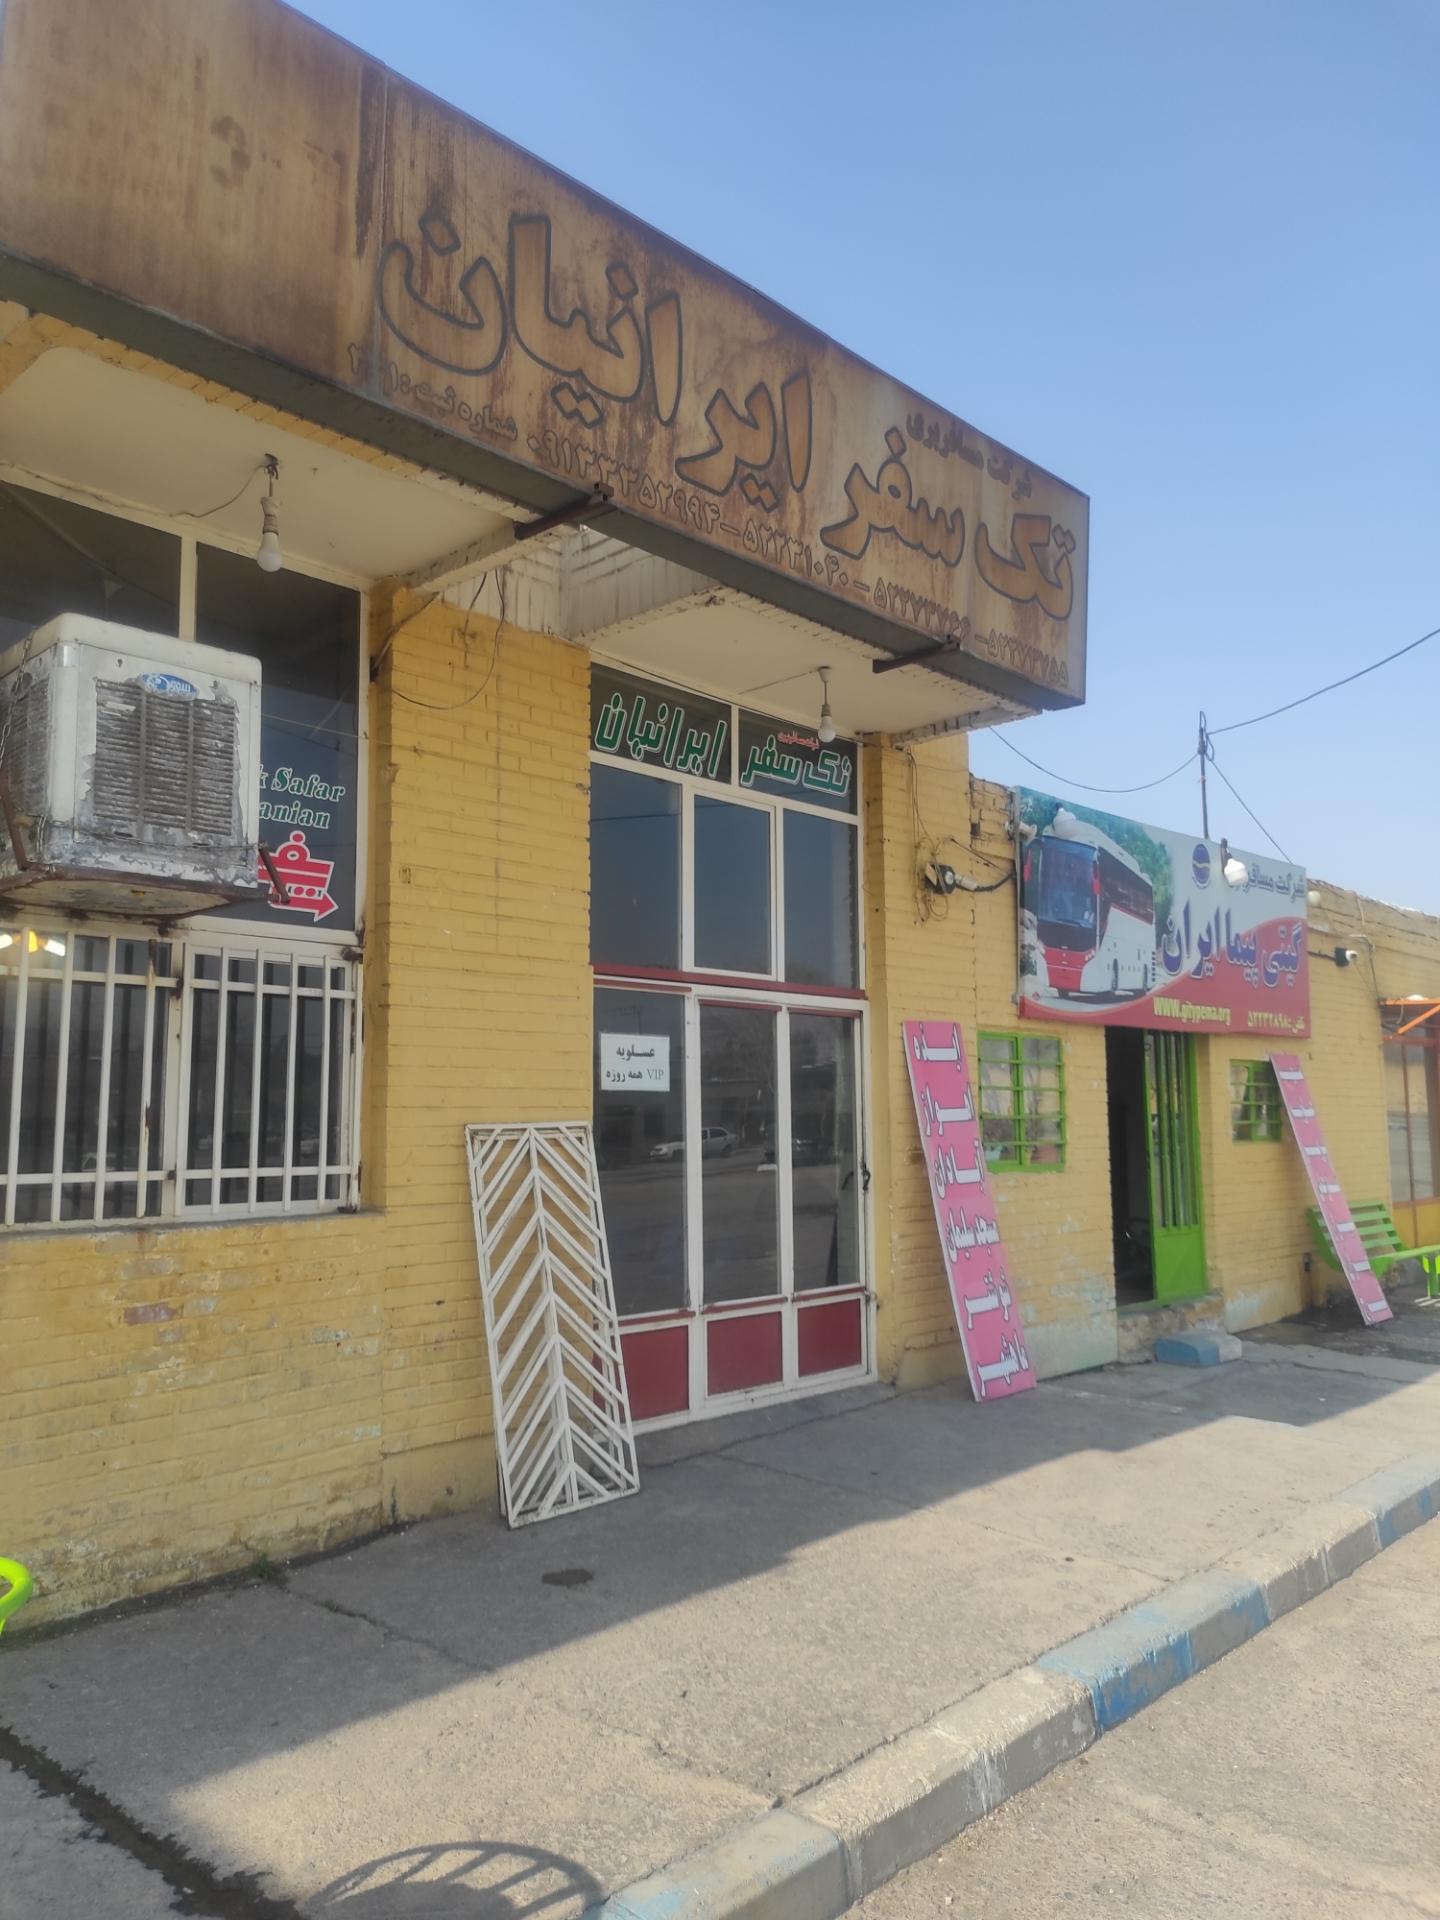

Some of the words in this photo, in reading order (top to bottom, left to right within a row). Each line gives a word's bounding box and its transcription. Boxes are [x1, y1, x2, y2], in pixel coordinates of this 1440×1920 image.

[378, 212, 813, 512] ایرانیان
[457, 400, 518, 441] شماره
[820, 426, 966, 567] سفر
[742, 517, 849, 586] ۵۲۲۳۱۰۴۰
[976, 512, 1077, 622] تک
[594, 692, 728, 778] ایرانیان
[740, 734, 802, 787] سفر
[271, 766, 346, 803] Safar
[259, 800, 331, 829] anian
[1274, 872, 1306, 904] شرکت
[1160, 898, 1222, 979] ایران
[1224, 907, 1259, 989] پیما
[1261, 919, 1304, 988] گیتی
[615, 1044, 656, 1061] عسلویه
[912, 1022, 962, 1072] ایذه
[606, 1070, 626, 1083] روزه
[627, 1070, 643, 1080] همه
[646, 1069, 665, 1081] VIP
[920, 1081, 976, 1138] اهواز
[934, 1138, 986, 1200] آبادان
[946, 1205, 975, 1265] سلیمان
[974, 1212, 1001, 1256] مسجد
